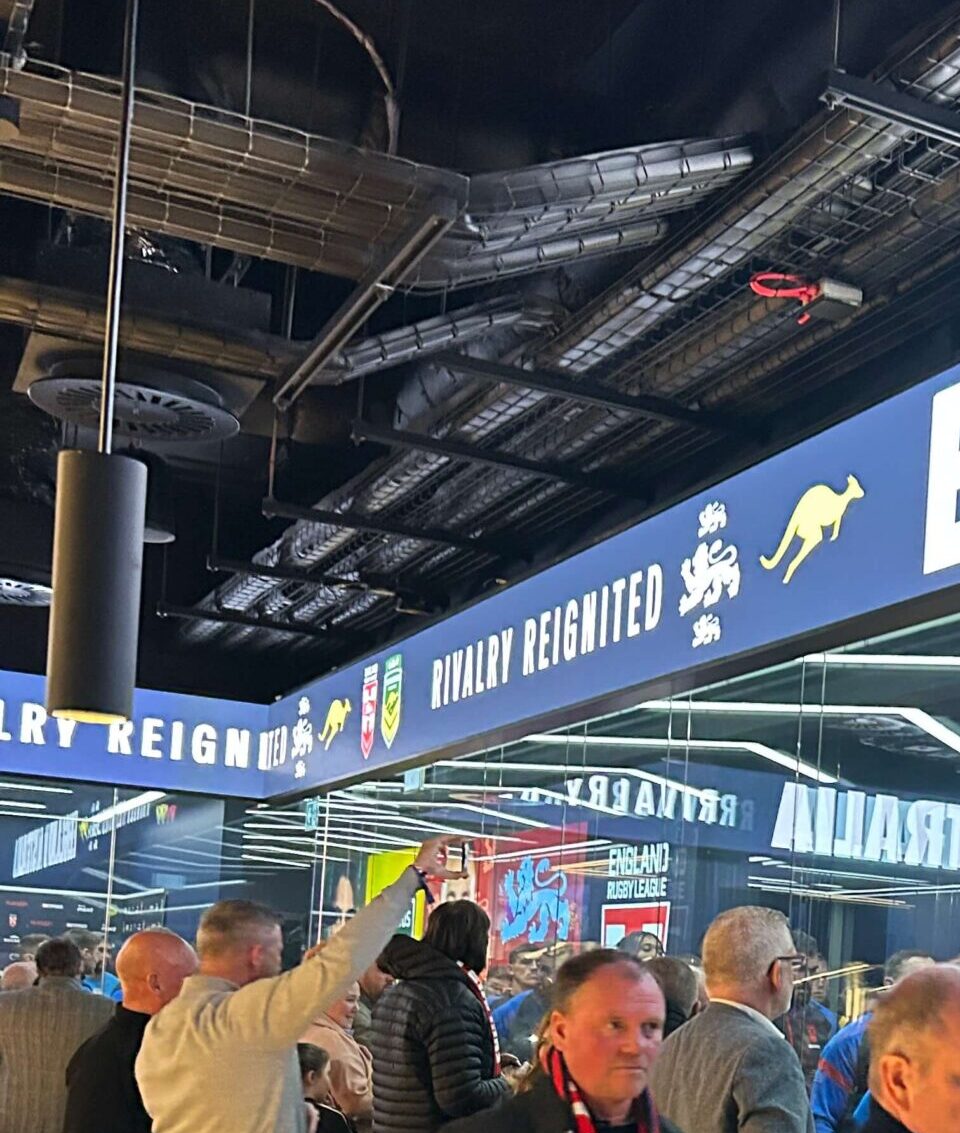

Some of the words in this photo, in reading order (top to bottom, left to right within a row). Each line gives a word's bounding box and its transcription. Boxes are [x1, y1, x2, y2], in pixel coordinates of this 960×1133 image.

[431, 627, 514, 710] RIVALRY
[523, 563, 663, 676] REIGNITED
[107, 716, 287, 771] REIGNITED
[608, 842, 670, 877] ENGLAND
[606, 880, 634, 900] RUGBY
[634, 877, 667, 899] LEAGUE
